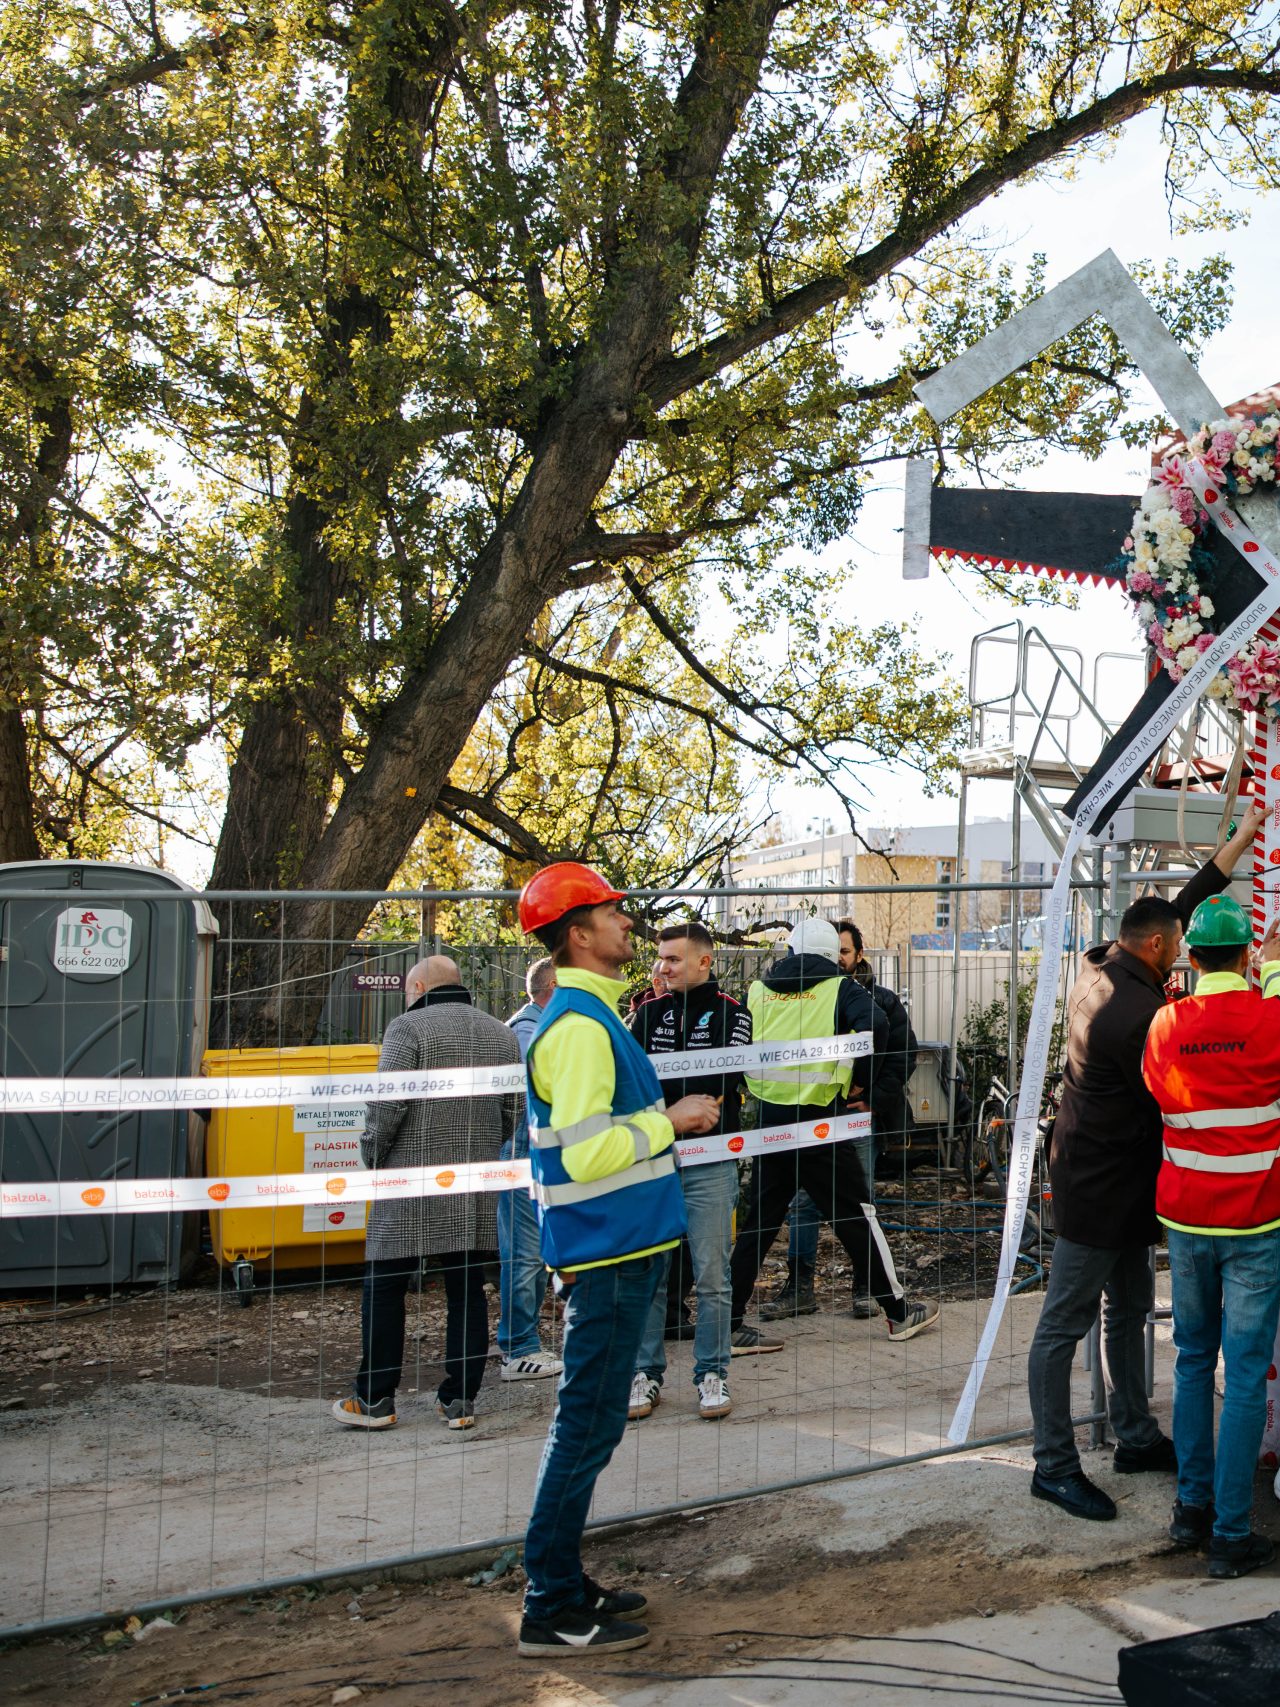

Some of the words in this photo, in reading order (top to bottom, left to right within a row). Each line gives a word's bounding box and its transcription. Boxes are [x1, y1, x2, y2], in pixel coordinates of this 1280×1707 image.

[1227, 602, 1268, 642] BUDOWA
[1149, 667, 1208, 739] REJONOWEGO
[1141, 736, 1151, 749] W
[1082, 779, 1115, 818] WIECHA
[60, 923, 127, 949] IDC
[57, 957, 78, 967] 666
[81, 957, 102, 967] 622
[104, 957, 127, 968] 020
[694, 1059, 706, 1070] W
[709, 1054, 745, 1070] ŁODZI
[759, 1048, 808, 1063] WIECHA
[810, 1040, 870, 1058] 29.10.2025
[1180, 1041, 1247, 1056] HAKOWY
[95, 1088, 220, 1103] REJONOWEGO
[224, 1087, 241, 1100] W
[311, 1083, 374, 1097] WIECHA
[377, 1079, 455, 1095] 29.10.2025
[297, 1111, 327, 1119] METALE
[333, 1110, 367, 1118] TWORZY
[317, 1119, 356, 1128] SZTUCZNE
[314, 1141, 358, 1151] PLASTIK
[679, 1145, 705, 1156] alzola
[763, 1132, 793, 1143] balzola
[313, 1160, 359, 1169] пластик
[2, 1192, 48, 1203] balzola
[134, 1188, 176, 1199] balzola
[256, 1184, 297, 1195] balzola
